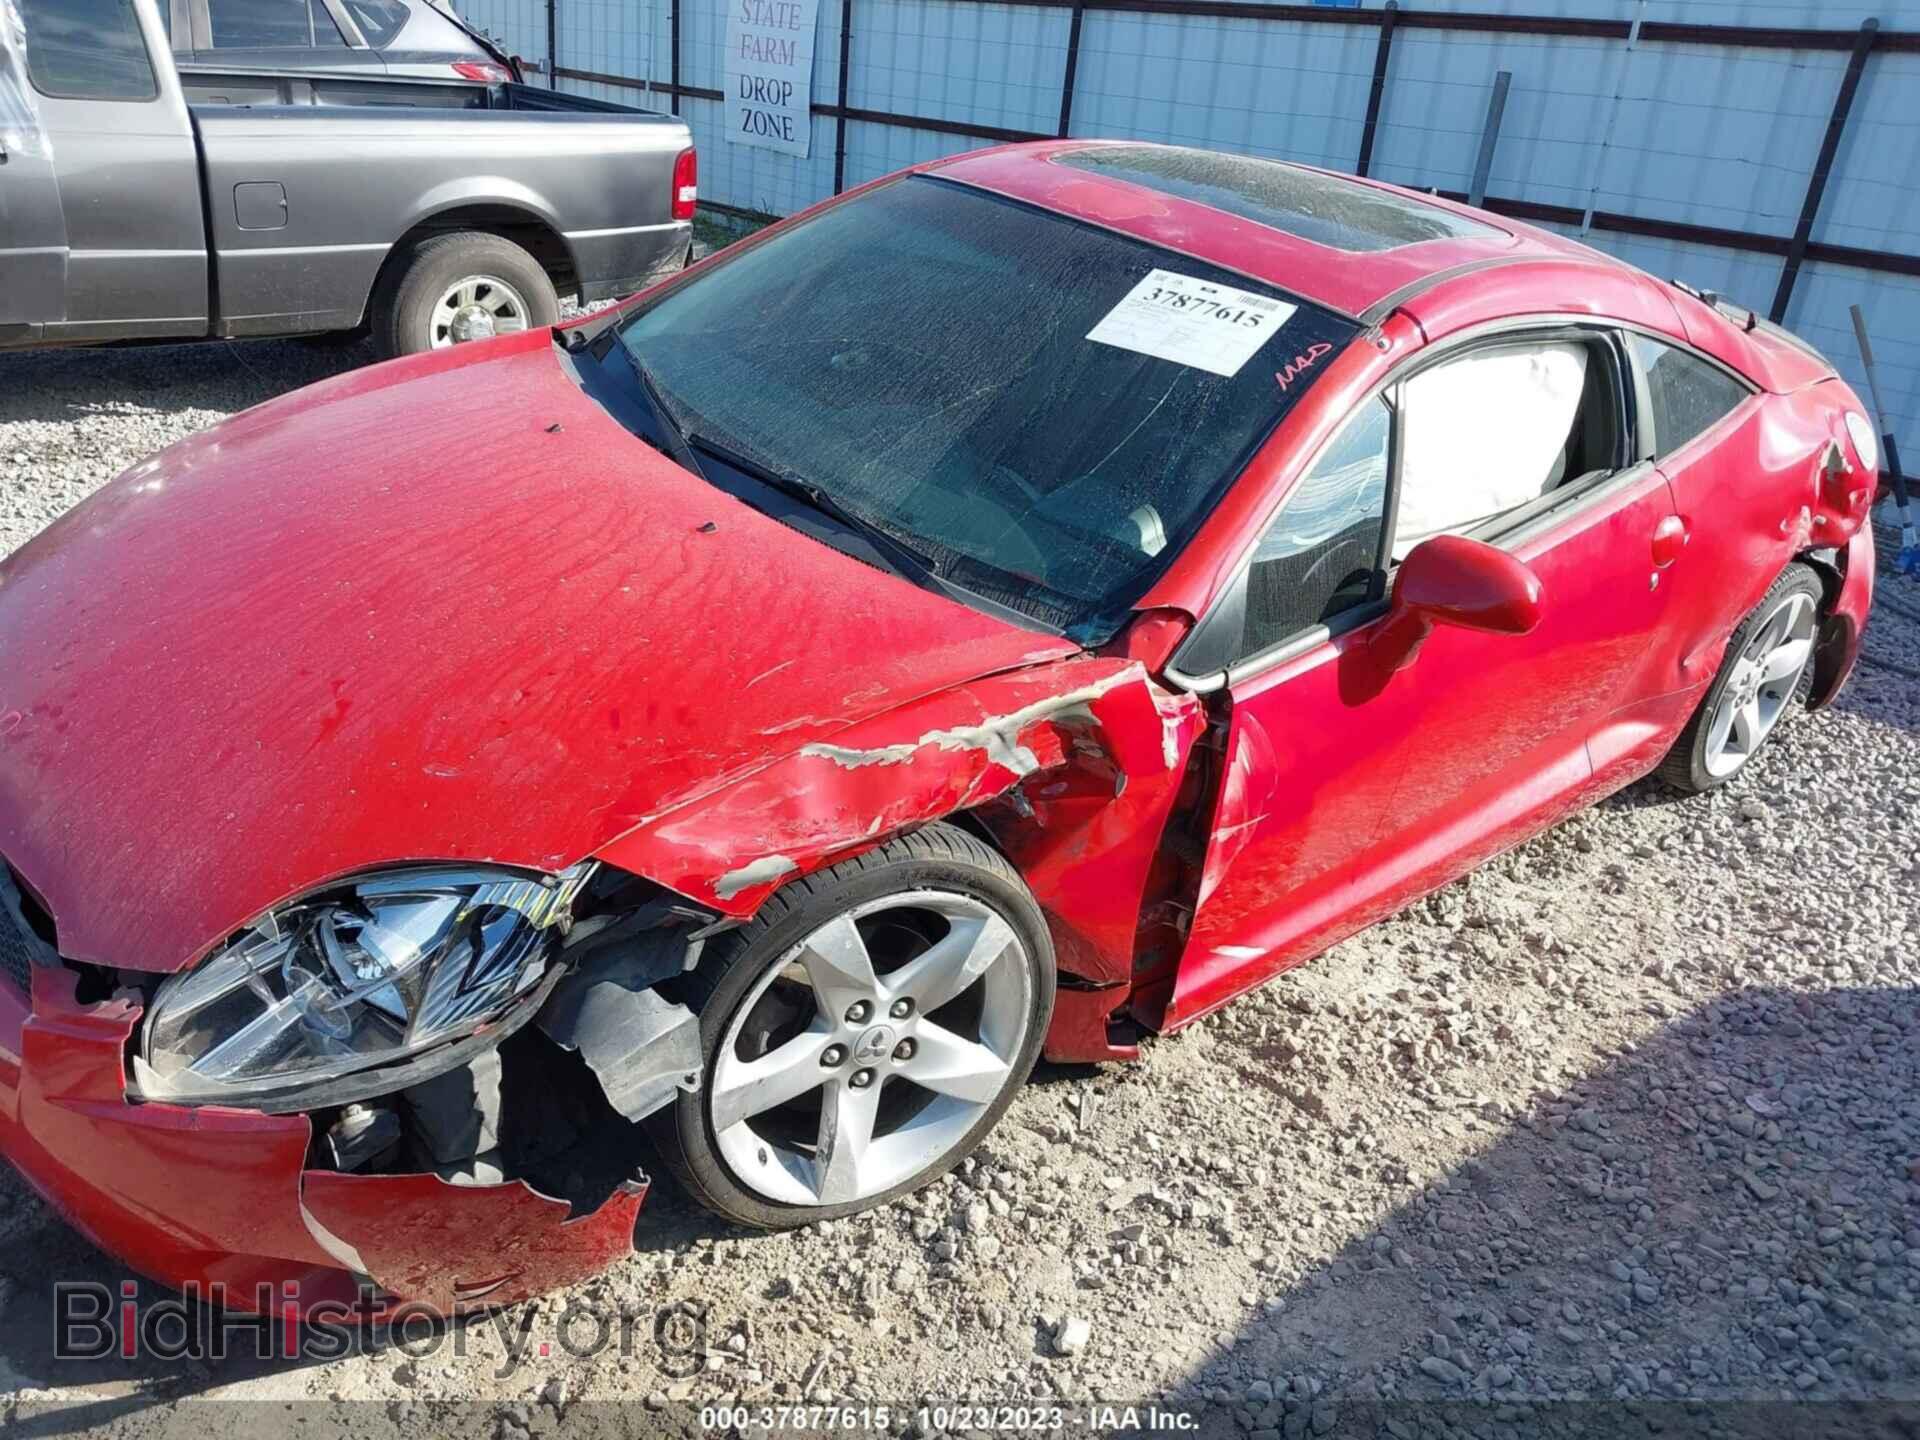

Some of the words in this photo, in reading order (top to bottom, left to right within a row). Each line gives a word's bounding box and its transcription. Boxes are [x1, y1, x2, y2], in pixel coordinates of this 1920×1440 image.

[740, 0, 801, 31] STATE
[740, 33, 797, 66] FARM
[740, 74, 793, 106] DROP
[741, 108, 795, 142] ZONE
[1143, 287, 1265, 328] 37877615
